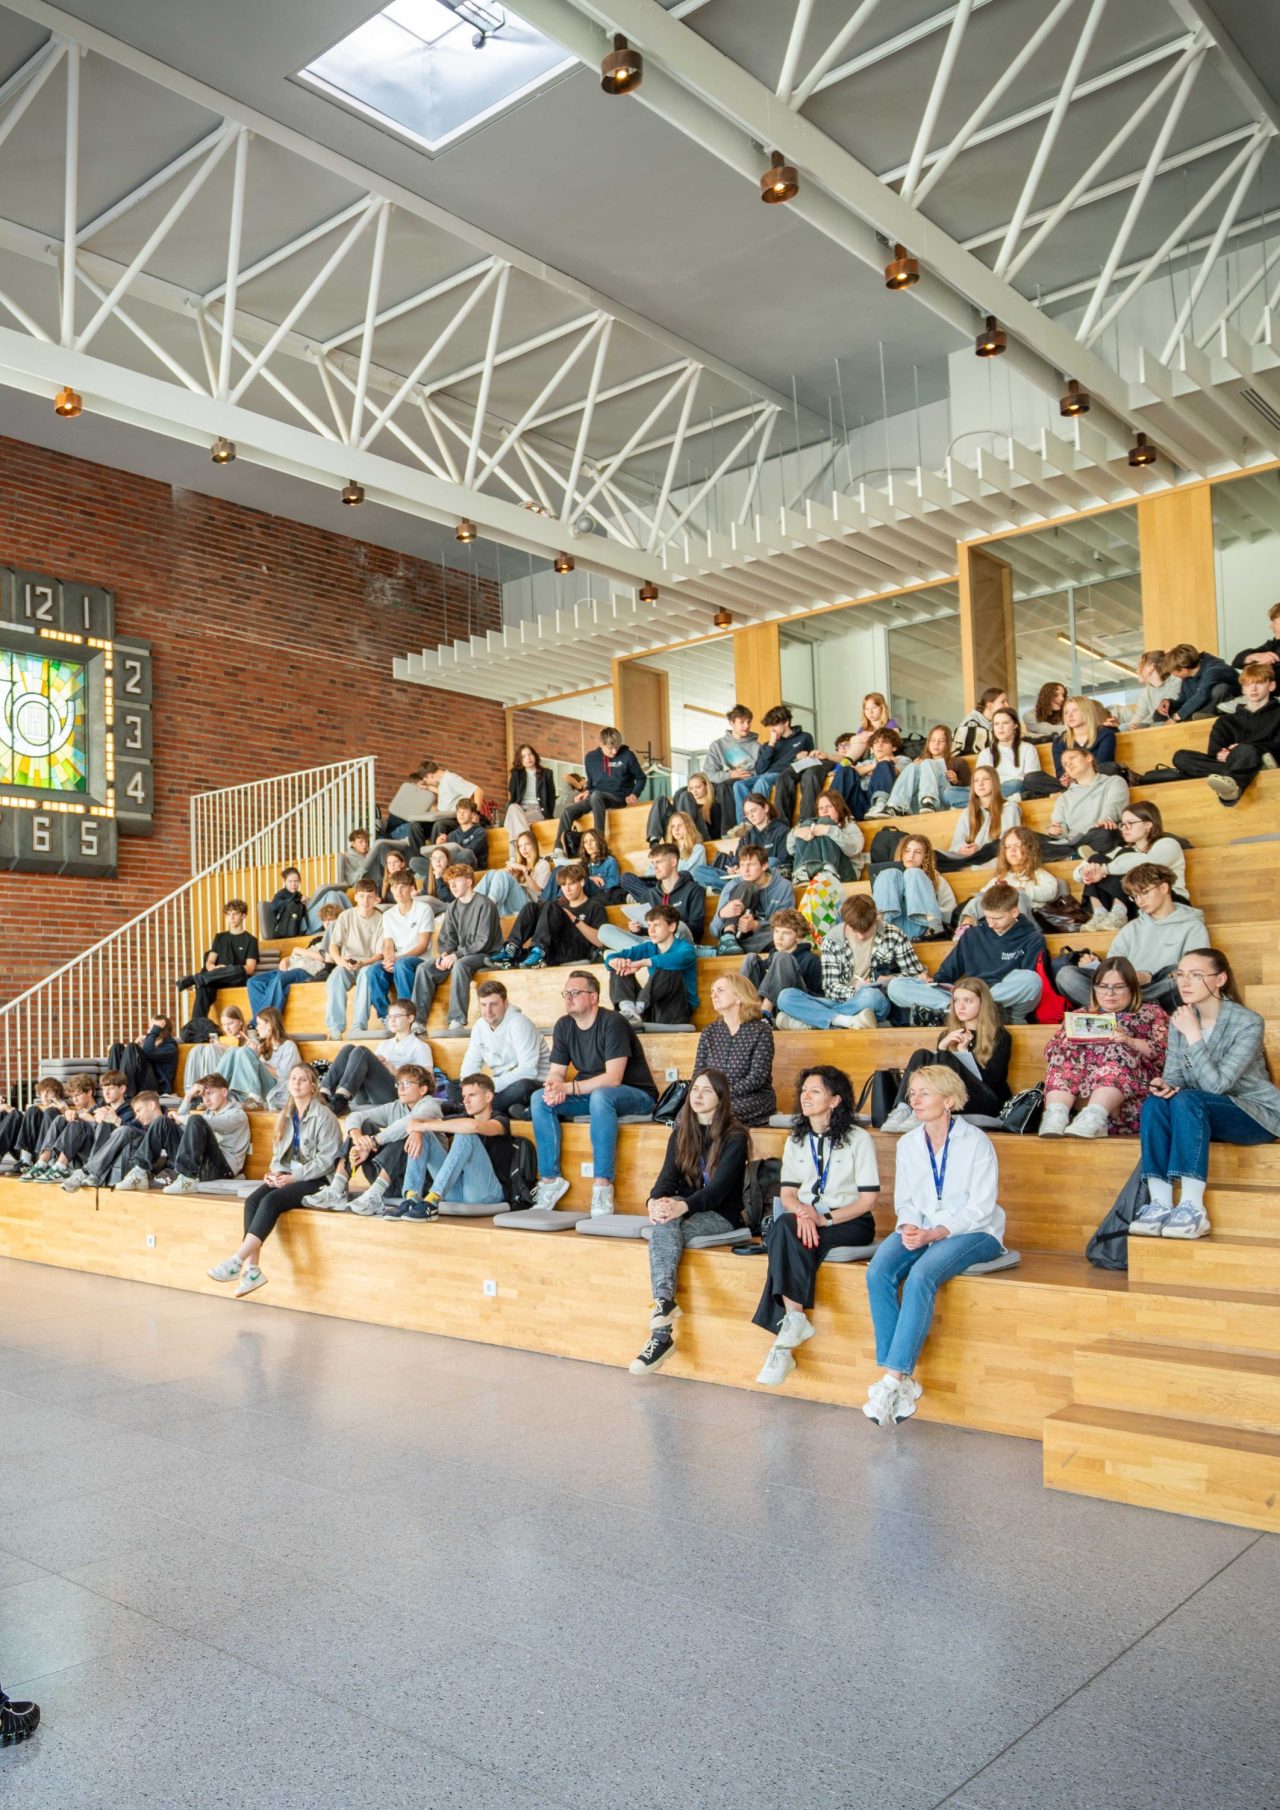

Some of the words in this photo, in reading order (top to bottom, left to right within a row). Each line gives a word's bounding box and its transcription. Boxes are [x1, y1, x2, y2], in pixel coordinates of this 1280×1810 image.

[25, 583, 53, 622] 12
[83, 596, 90, 630] 1
[125, 659, 141, 694] 2
[125, 715, 141, 749] 3
[126, 771, 145, 804] 4
[33, 816, 50, 852] 6
[81, 820, 98, 856] 5
